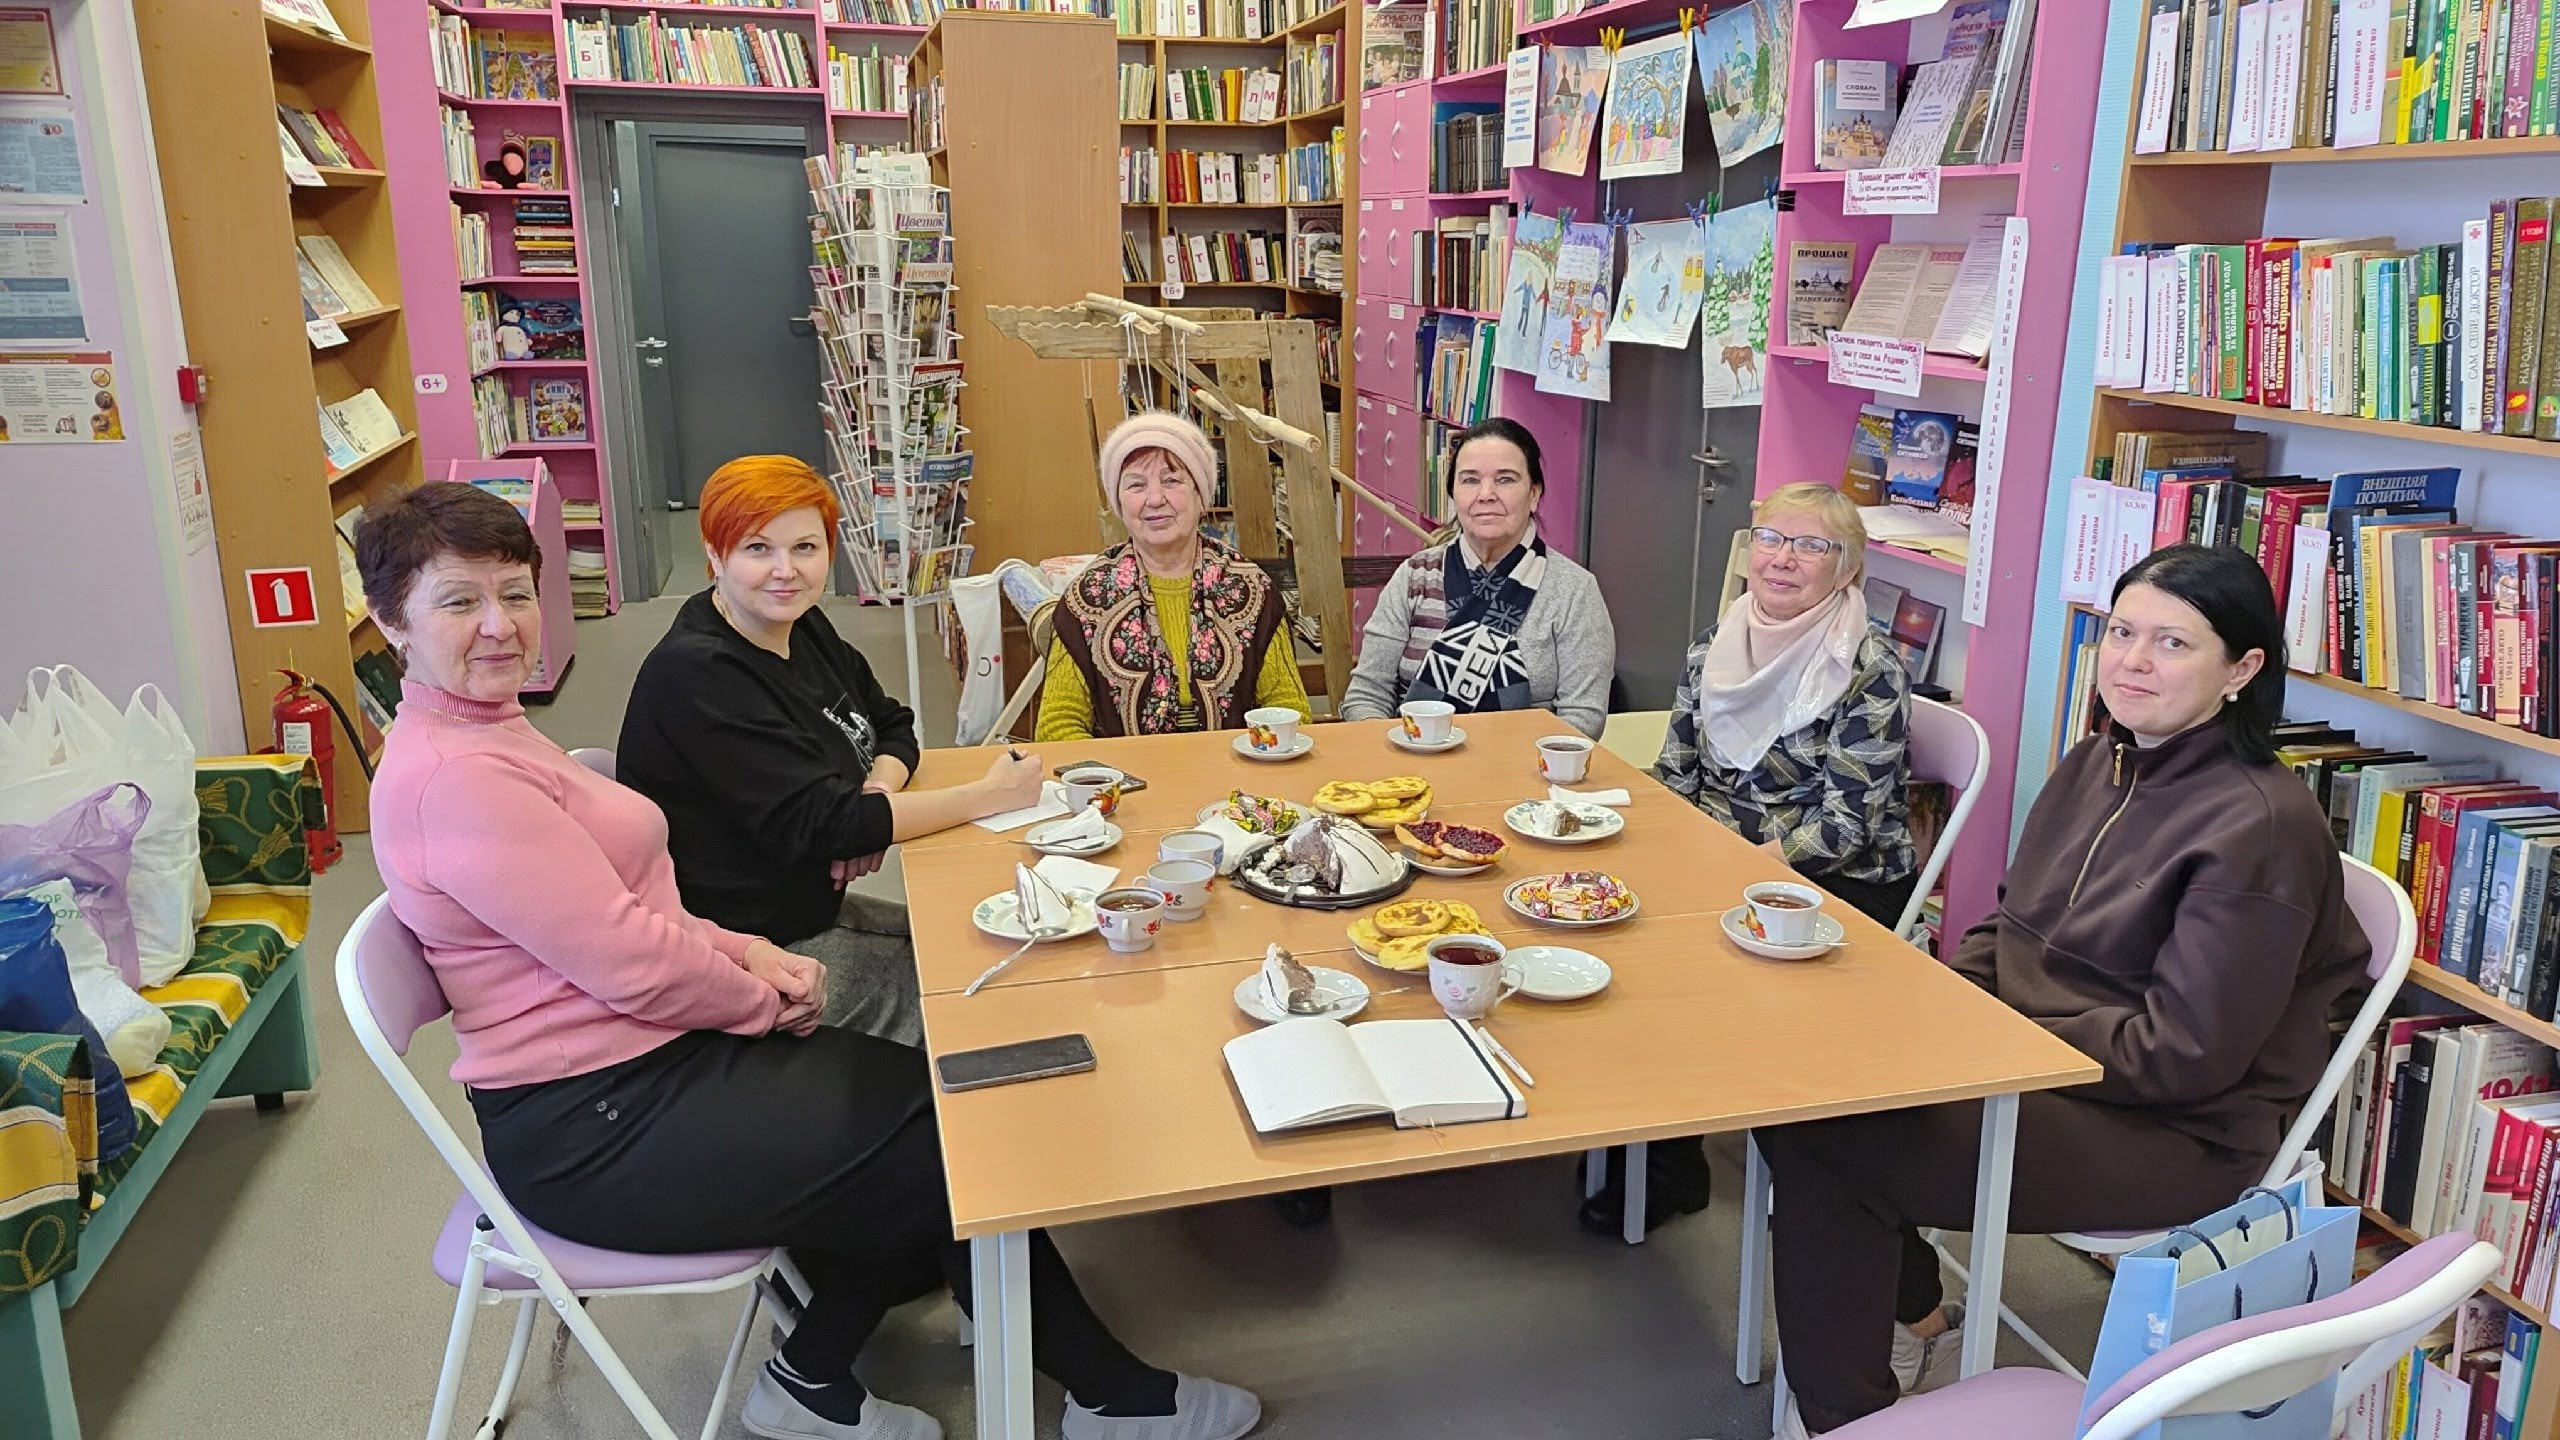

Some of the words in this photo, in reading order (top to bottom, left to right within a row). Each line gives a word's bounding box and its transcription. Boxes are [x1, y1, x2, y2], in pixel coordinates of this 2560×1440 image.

[1187, 5, 1196, 15] Б
[1248, 7, 1256, 17] В
[2540, 17, 2551, 36] БЕЗ
[582, 50, 591, 61] Б
[2364, 28, 2377, 111] овощеводство
[2441, 33, 2456, 100] ОГОРОДНИКАМ
[2535, 39, 2548, 80] ОГОРОД
[2283, 53, 2292, 94] основы
[2350, 40, 2362, 115] Садоводство
[2357, 29, 2362, 37] и
[2460, 50, 2475, 117] ТЕПЛИЦЫ
[1174, 93, 1182, 103] Е
[1264, 90, 1275, 101] М
[1203, 174, 1212, 184] Н
[1223, 173, 1231, 183] П
[1264, 173, 1271, 183] Р
[901, 215, 945, 228] Цветок
[1797, 249, 1849, 258] ПРОШЛОЕ
[2491, 212, 2506, 271] МЕДИЦИНЫ
[1167, 254, 1175, 264] С
[1256, 256, 1265, 266] Ц
[2223, 260, 2232, 290] УХОДУ
[2444, 251, 2456, 319] ЛЕКАРСТВЕННЫЕ
[2469, 265, 2480, 315] ДОКТОР
[2262, 260, 2273, 325] заболеваний
[2271, 277, 2280, 325] условиях
[2276, 257, 2290, 332] справочник
[2451, 277, 2461, 319] СРЕДСТВА
[2487, 275, 2502, 330] НАРОДНОЙ
[2230, 288, 2238, 338] БОЛЬНЫМИ
[2409, 301, 2418, 357] ПИРОГОВ
[2468, 318, 2480, 349] СЕБЕ
[2469, 354, 2479, 380] САМ
[2486, 334, 2498, 369] КНИГА
[2519, 323, 2534, 385] НАРОДНОЙ
[421, 378, 442, 389] 6+
[2423, 346, 2433, 415] МЕДИЦИНЫ
[2482, 373, 2496, 421] ЗОЛОТАЯ
[2354, 489, 2426, 506] ПОЛИТИКА
[2361, 475, 2429, 491] ВНЕШНЯЯ
[2091, 516, 2099, 545] целом
[2275, 523, 2285, 550] МИРА
[2074, 513, 2088, 582] Общественные
[2088, 555, 2096, 582] науки
[2295, 604, 2306, 646] История
[2302, 562, 2311, 601] России
[2459, 596, 2472, 651] ТУХАЧЕВСКИЙ
[2497, 629, 2505, 653] ЛЕТО
[2430, 889, 2441, 917] ВЕЛИКИХ
[2456, 886, 2471, 906] РУСЬ
[2429, 917, 2437, 931] СТО
[2450, 908, 2468, 962] ДОПЕТРОВСКАЯ
[2528, 1188, 2541, 1222] ЖЕНСКОЕ
[2540, 1137, 2553, 1168] ПОБЕДЫ
